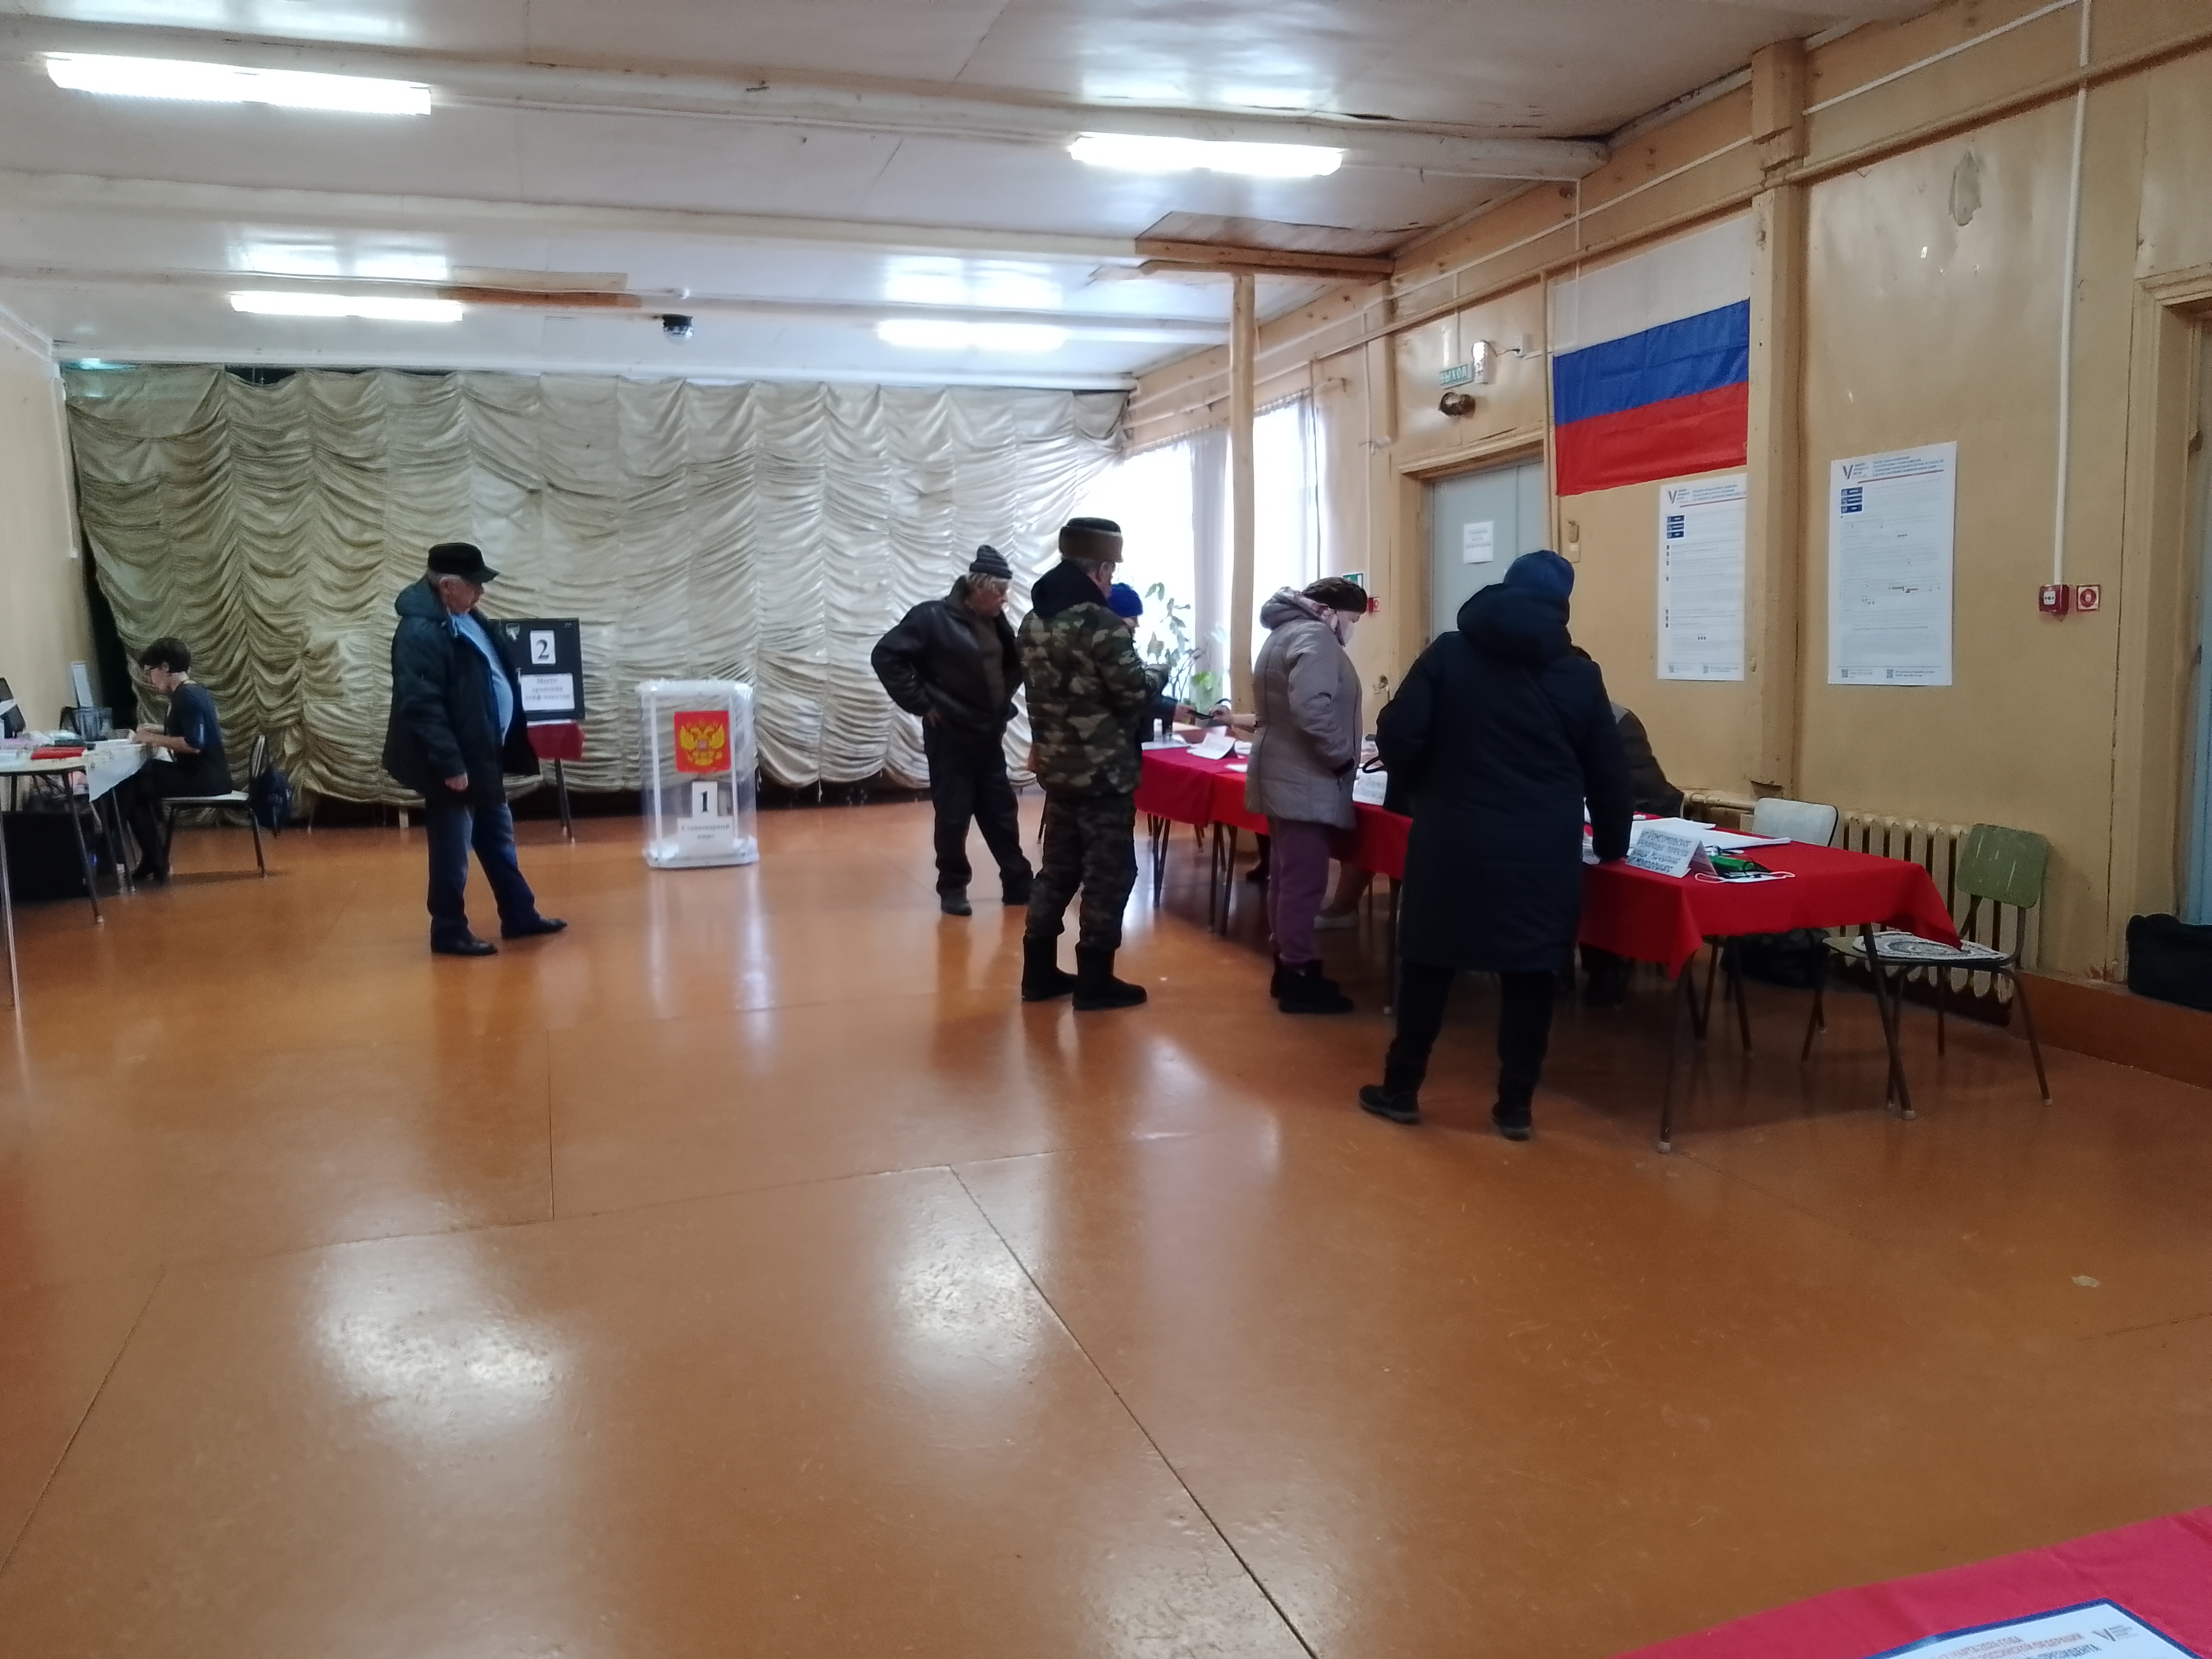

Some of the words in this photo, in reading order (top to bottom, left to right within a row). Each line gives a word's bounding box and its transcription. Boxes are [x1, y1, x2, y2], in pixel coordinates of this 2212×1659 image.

[1440, 366, 1467, 384] ВЫХОД
[536, 639, 550, 659] 2
[701, 791, 709, 812] 1
